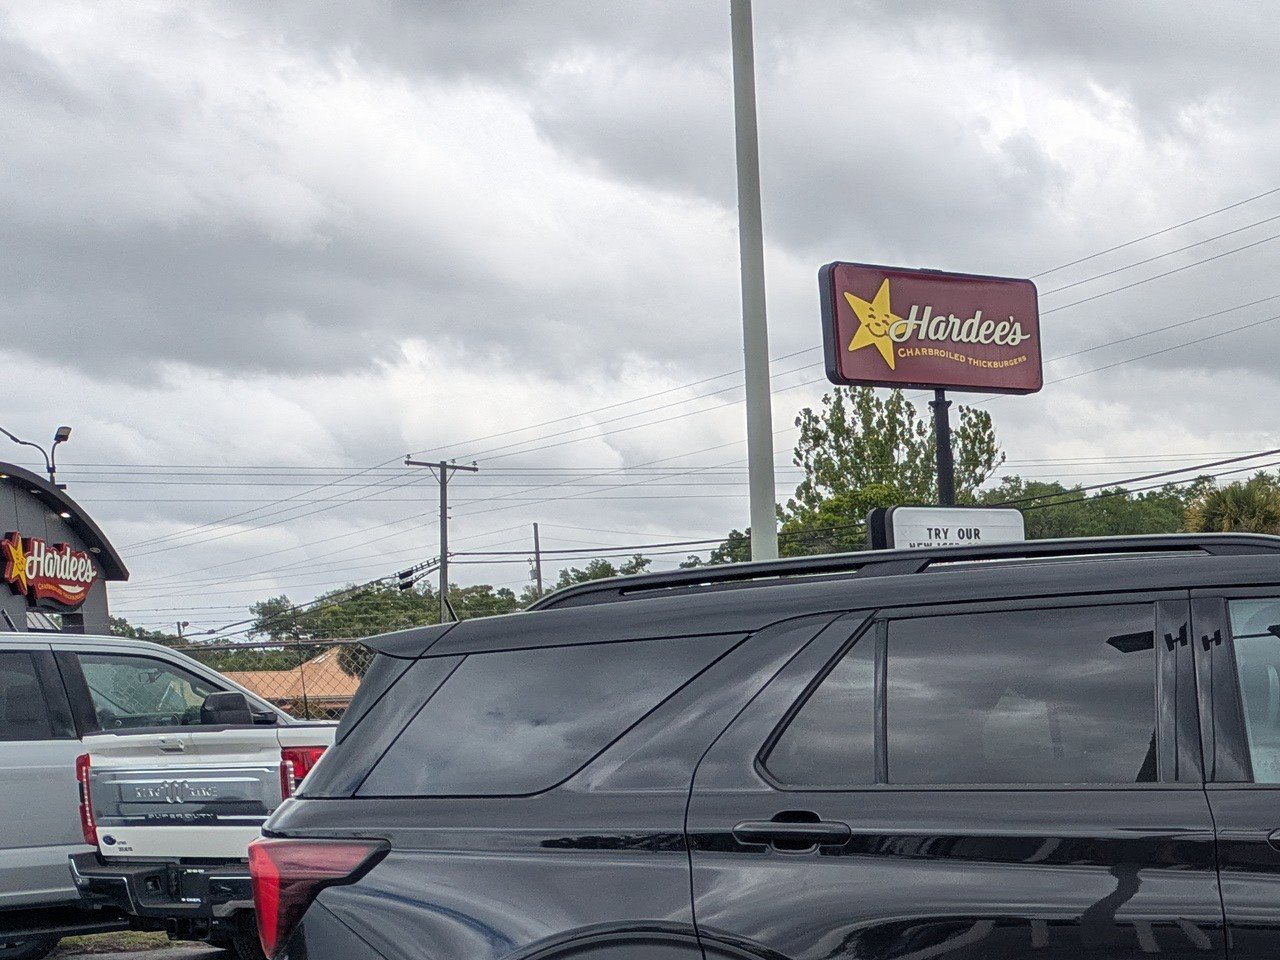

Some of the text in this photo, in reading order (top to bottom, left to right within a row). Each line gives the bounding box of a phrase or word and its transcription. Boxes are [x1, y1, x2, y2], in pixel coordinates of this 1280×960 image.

[888, 304, 1031, 347] Hardee's
[897, 347, 1027, 369] CHARBROILED THICKBURGERS
[926, 527, 981, 540] TRY OUR
[25, 540, 97, 583] Hardee's
